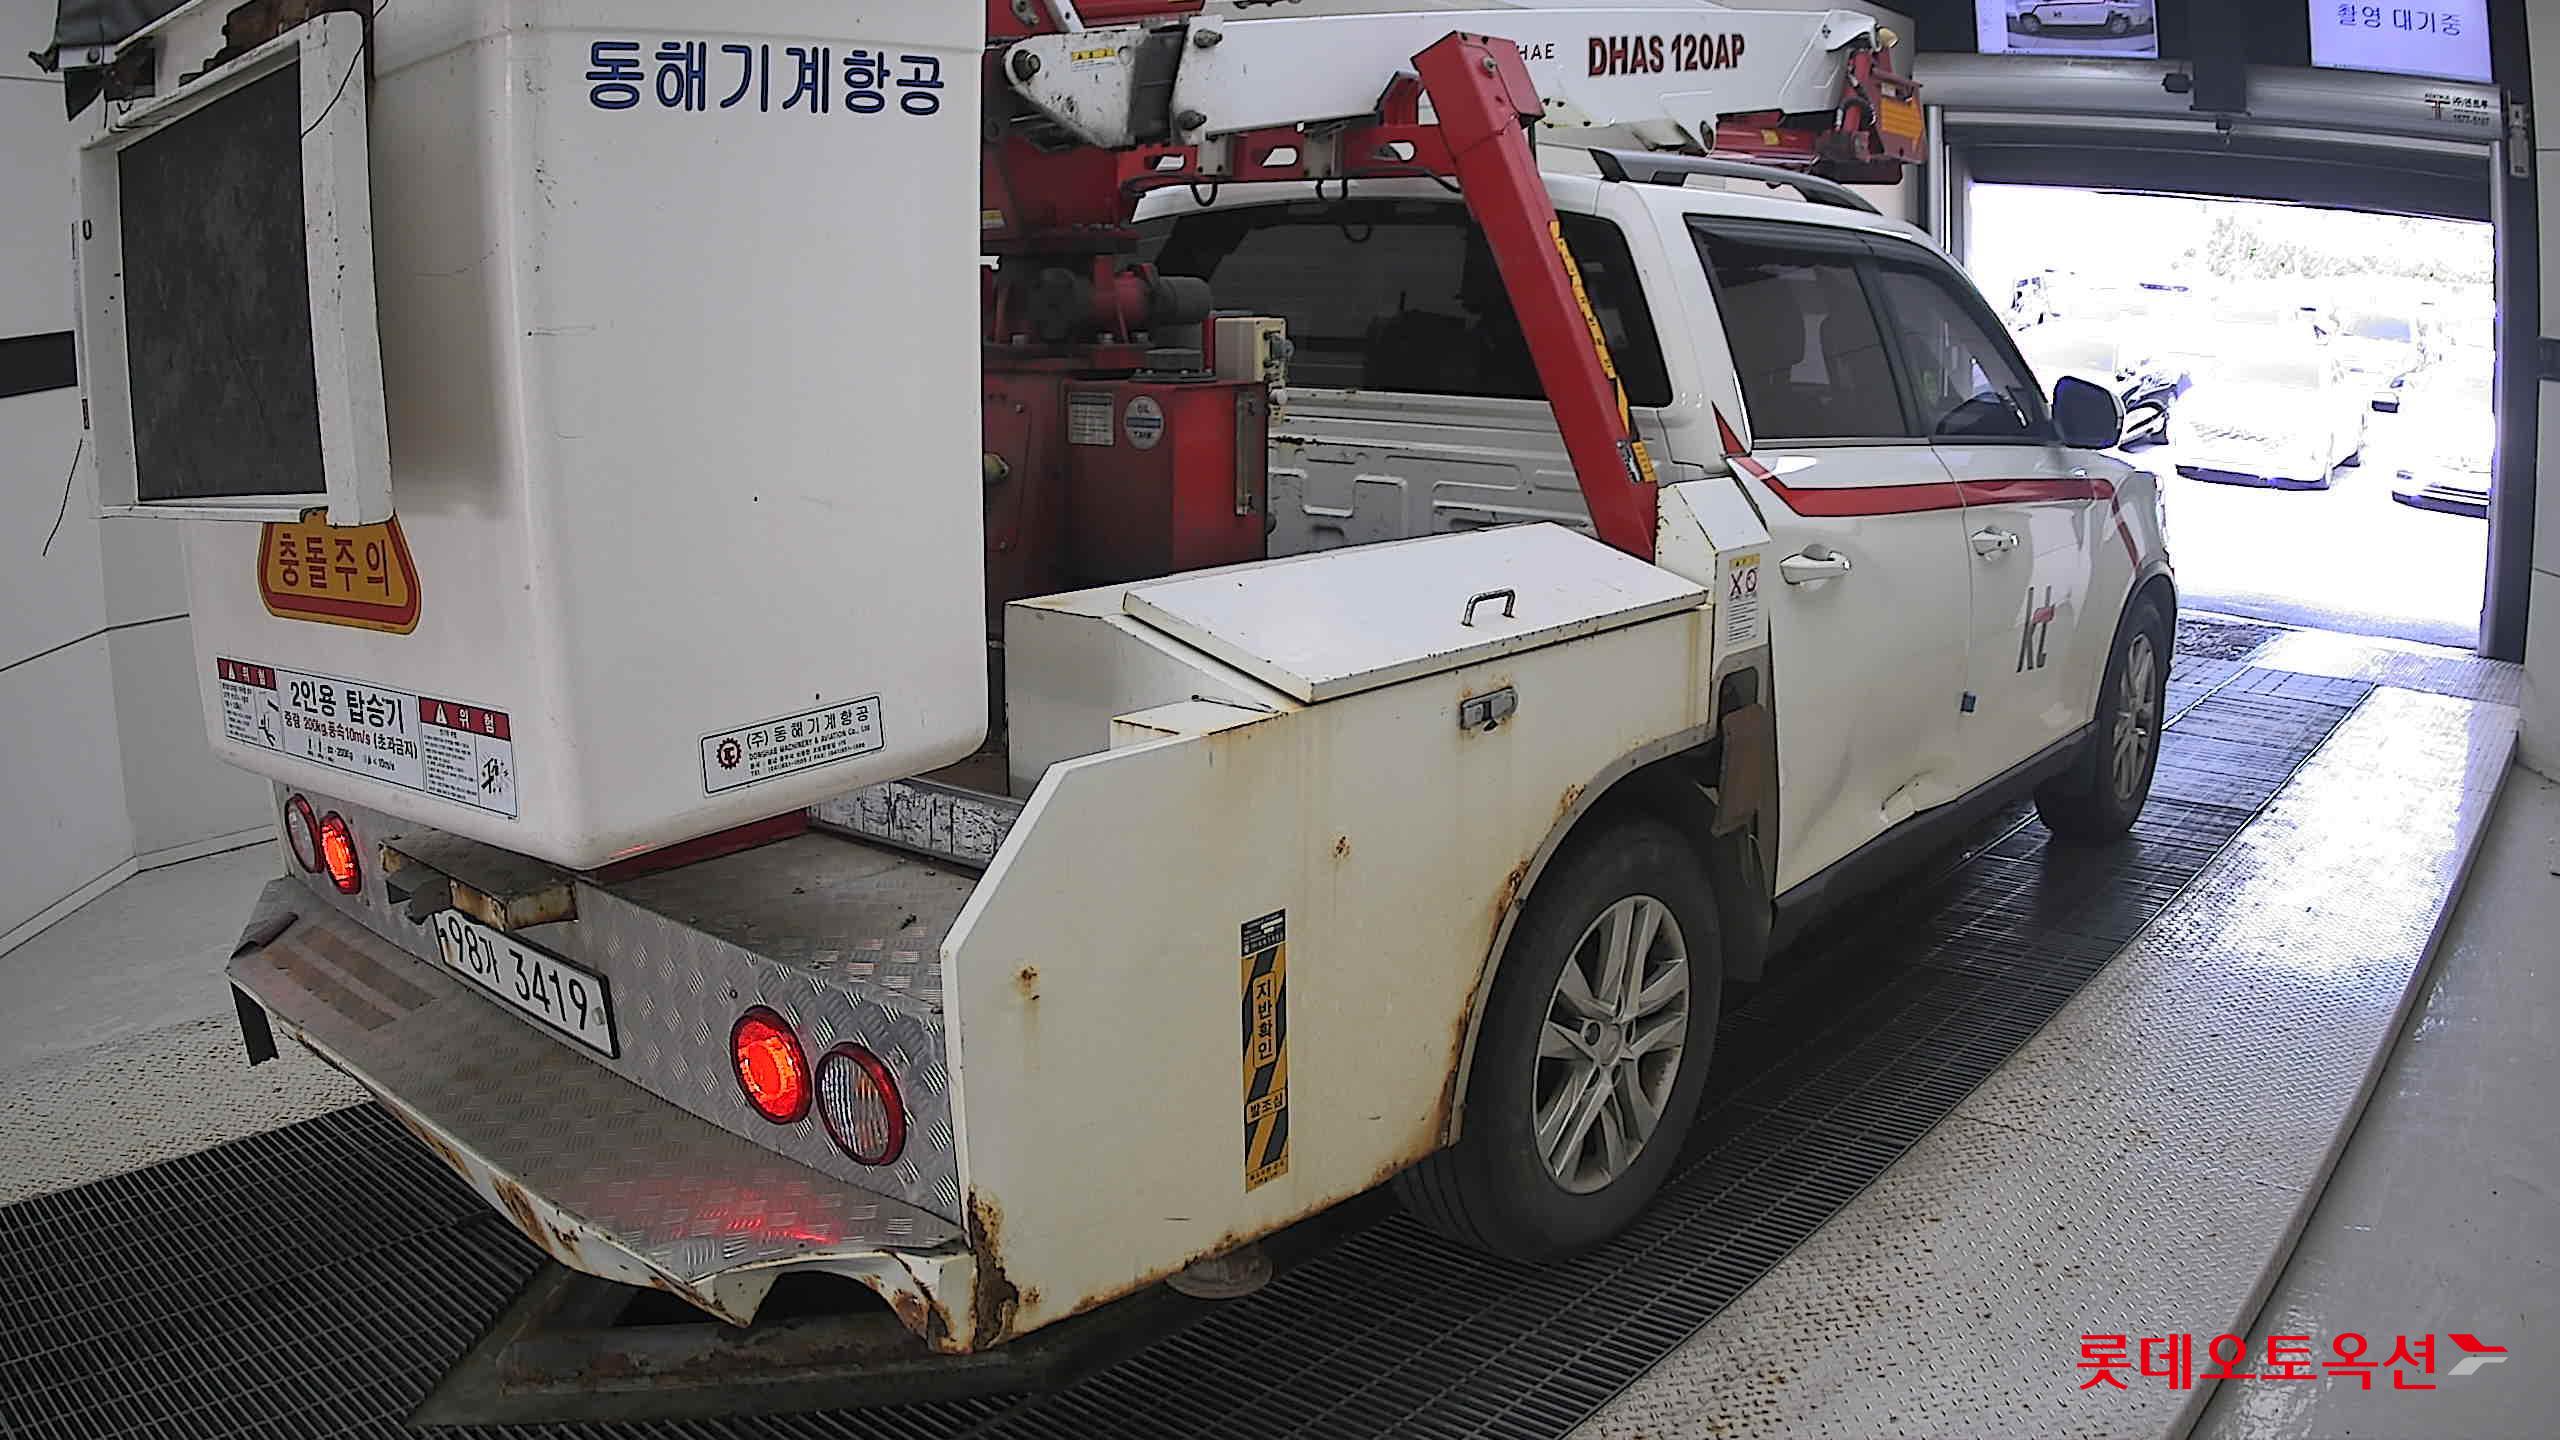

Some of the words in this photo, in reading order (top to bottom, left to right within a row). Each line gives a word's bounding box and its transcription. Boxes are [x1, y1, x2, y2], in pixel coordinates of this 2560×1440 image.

[2393, 8, 2461, 36] 대기중
[585, 41, 945, 116] 동해기계항공
[1588, 35, 1664, 77] DHAS
[1671, 33, 1744, 72] 120AP
[279, 532, 390, 597] 충돌주의
[2015, 585, 2056, 673] kt
[290, 680, 337, 717] 2인용
[346, 689, 404, 735] 탑승기
[459, 708, 494, 734] 위험
[746, 729, 769, 750] (주)
[773, 705, 870, 743] 동해기계항공
[448, 916, 500, 984] 98가
[508, 948, 588, 1030] 3419
[1256, 979, 1273, 1060] 지반확인
